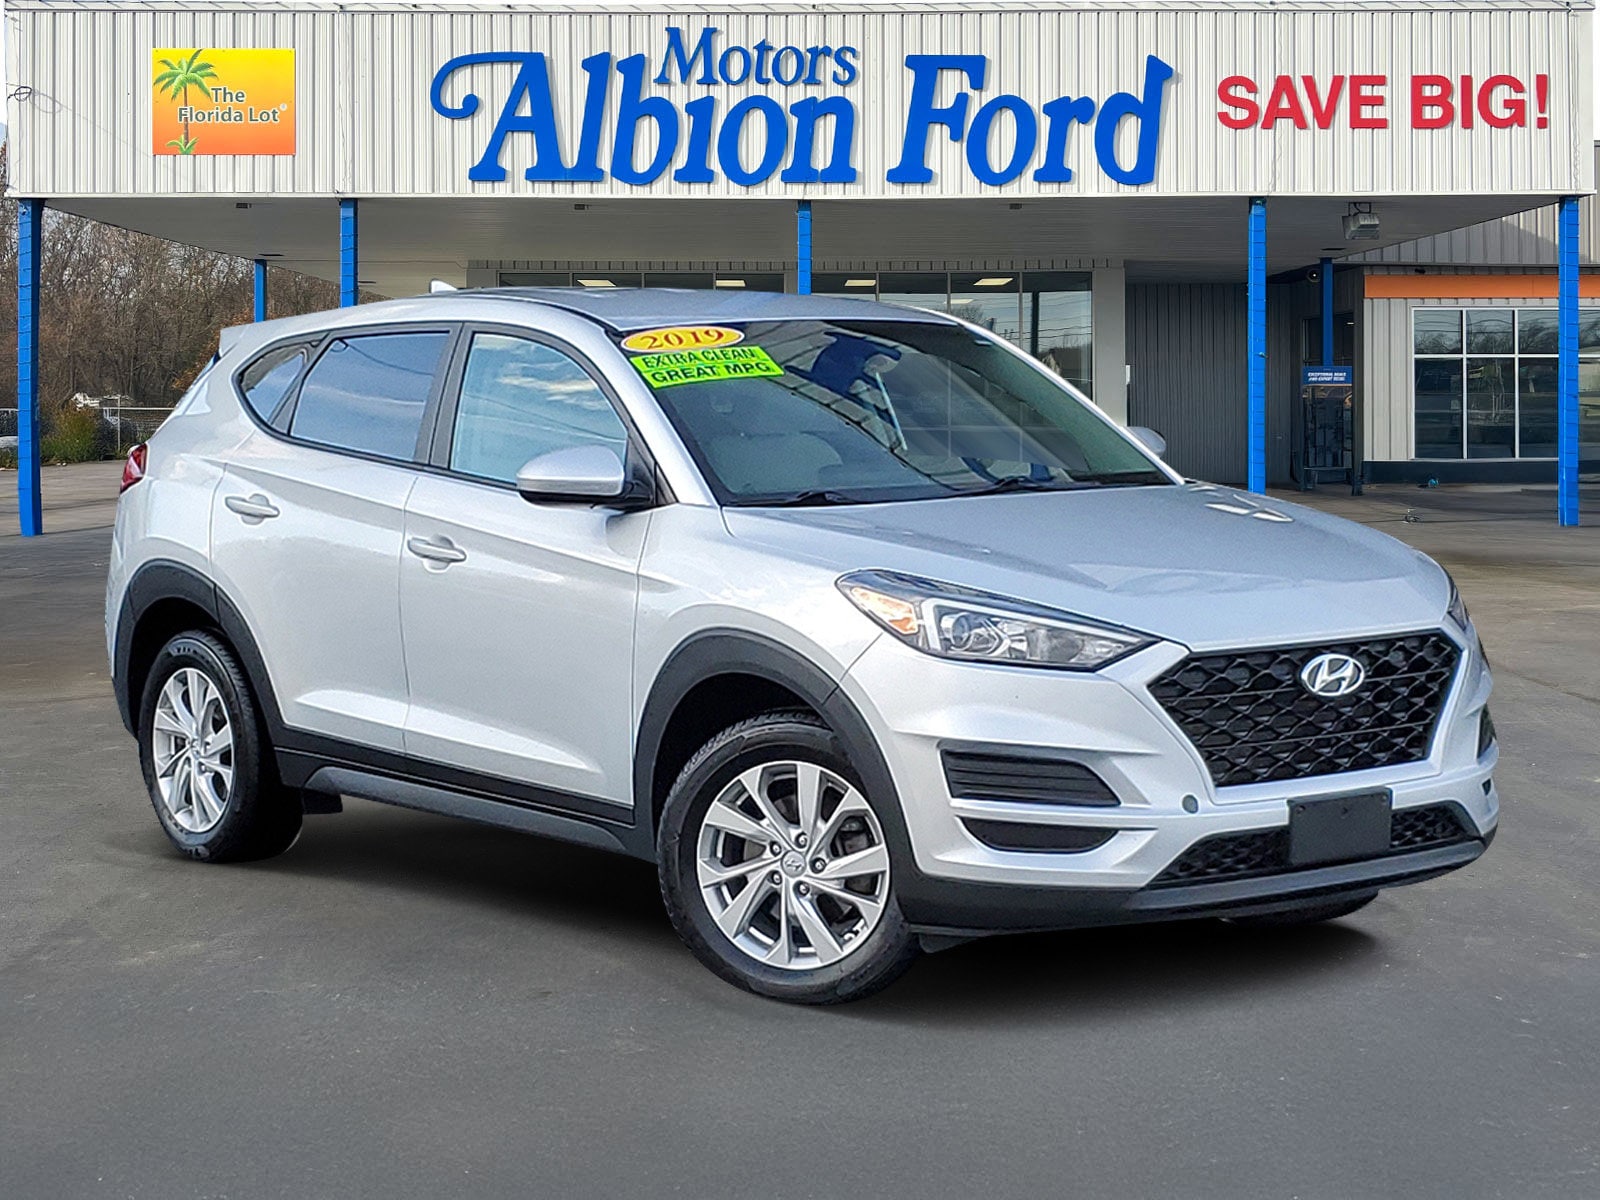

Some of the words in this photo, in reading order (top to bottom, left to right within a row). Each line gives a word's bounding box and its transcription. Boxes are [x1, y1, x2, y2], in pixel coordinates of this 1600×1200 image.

[654, 26, 860, 87] Motors
[211, 87, 245, 103] The
[1217, 75, 1389, 129] SAVE
[1411, 74, 1549, 129] BIG!
[178, 107, 244, 122] Florida
[249, 107, 279, 122] Lot
[430, 51, 857, 186] Albion
[886, 54, 1177, 186] Ford
[640, 329, 724, 350] 2019
[641, 351, 699, 369] EXTRA
[701, 348, 756, 361] CLEAN
[651, 365, 718, 383] GREAT
[724, 361, 771, 374] MPG
